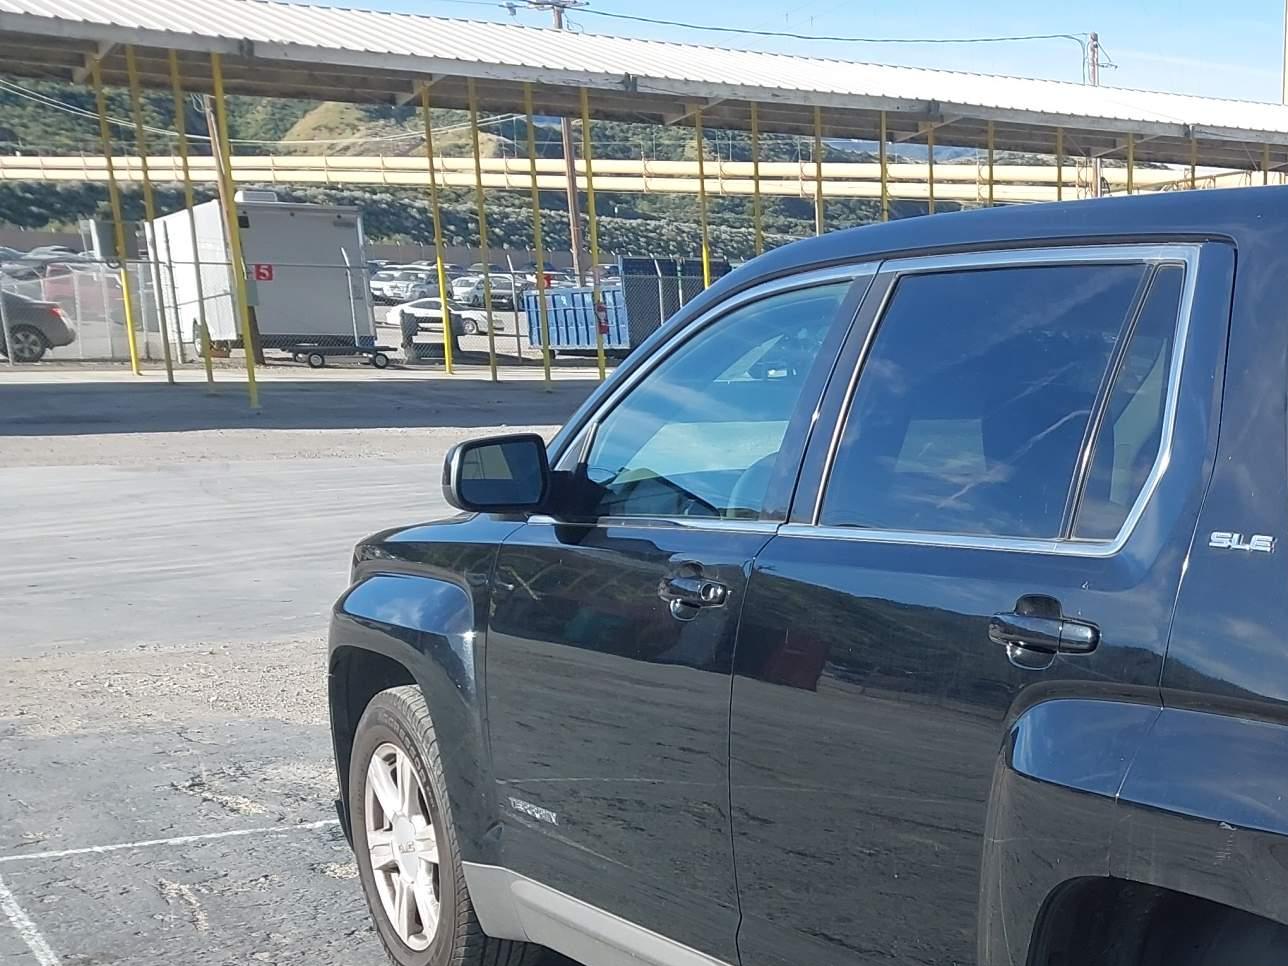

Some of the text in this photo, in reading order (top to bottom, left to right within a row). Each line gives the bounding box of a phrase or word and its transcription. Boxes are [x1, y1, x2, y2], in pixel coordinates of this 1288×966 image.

[258, 265, 271, 280] 5
[1208, 531, 1273, 553] SLE
[508, 796, 559, 827] TEIN
